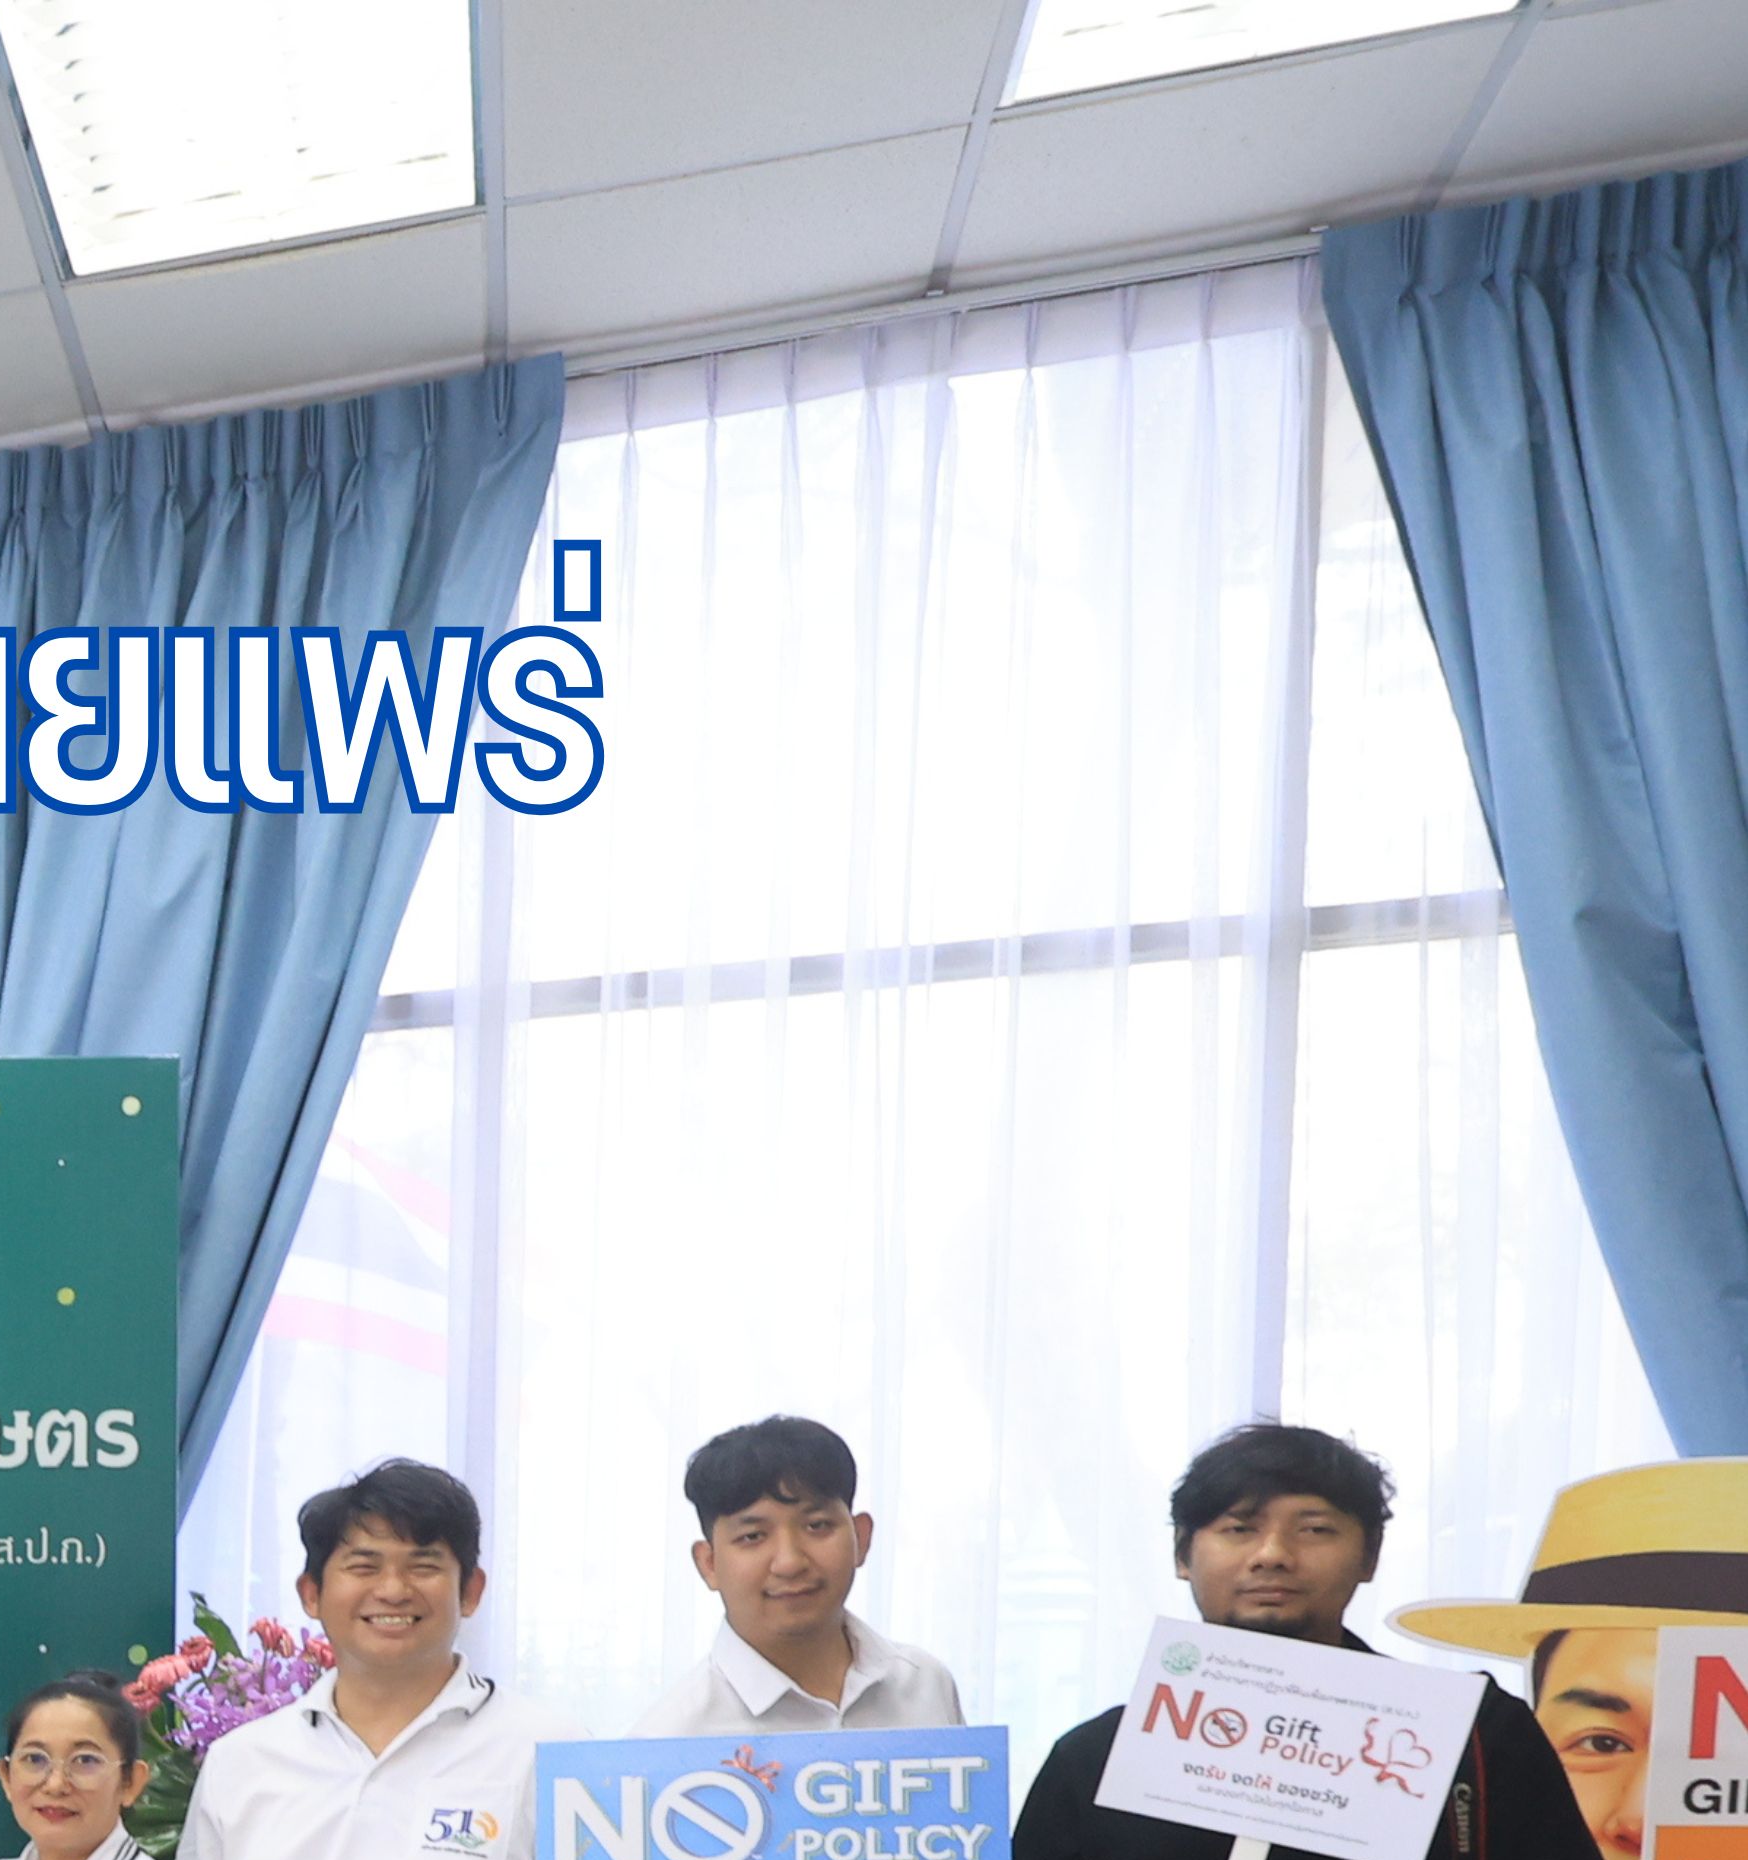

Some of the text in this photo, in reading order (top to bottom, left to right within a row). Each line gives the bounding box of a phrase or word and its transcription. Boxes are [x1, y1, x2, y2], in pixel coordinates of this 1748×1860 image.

[1689, 1656, 1748, 1759] N
[1264, 1715, 1323, 1744] Gift
[1260, 1735, 1353, 1776] Policy
[794, 1755, 990, 1815] GIFT
[1183, 1761, 1226, 1781] งดรับ
[1277, 1781, 1350, 1809] ของขวัญ
[1683, 1778, 1748, 1814] GI
[425, 1808, 473, 1842] 51
